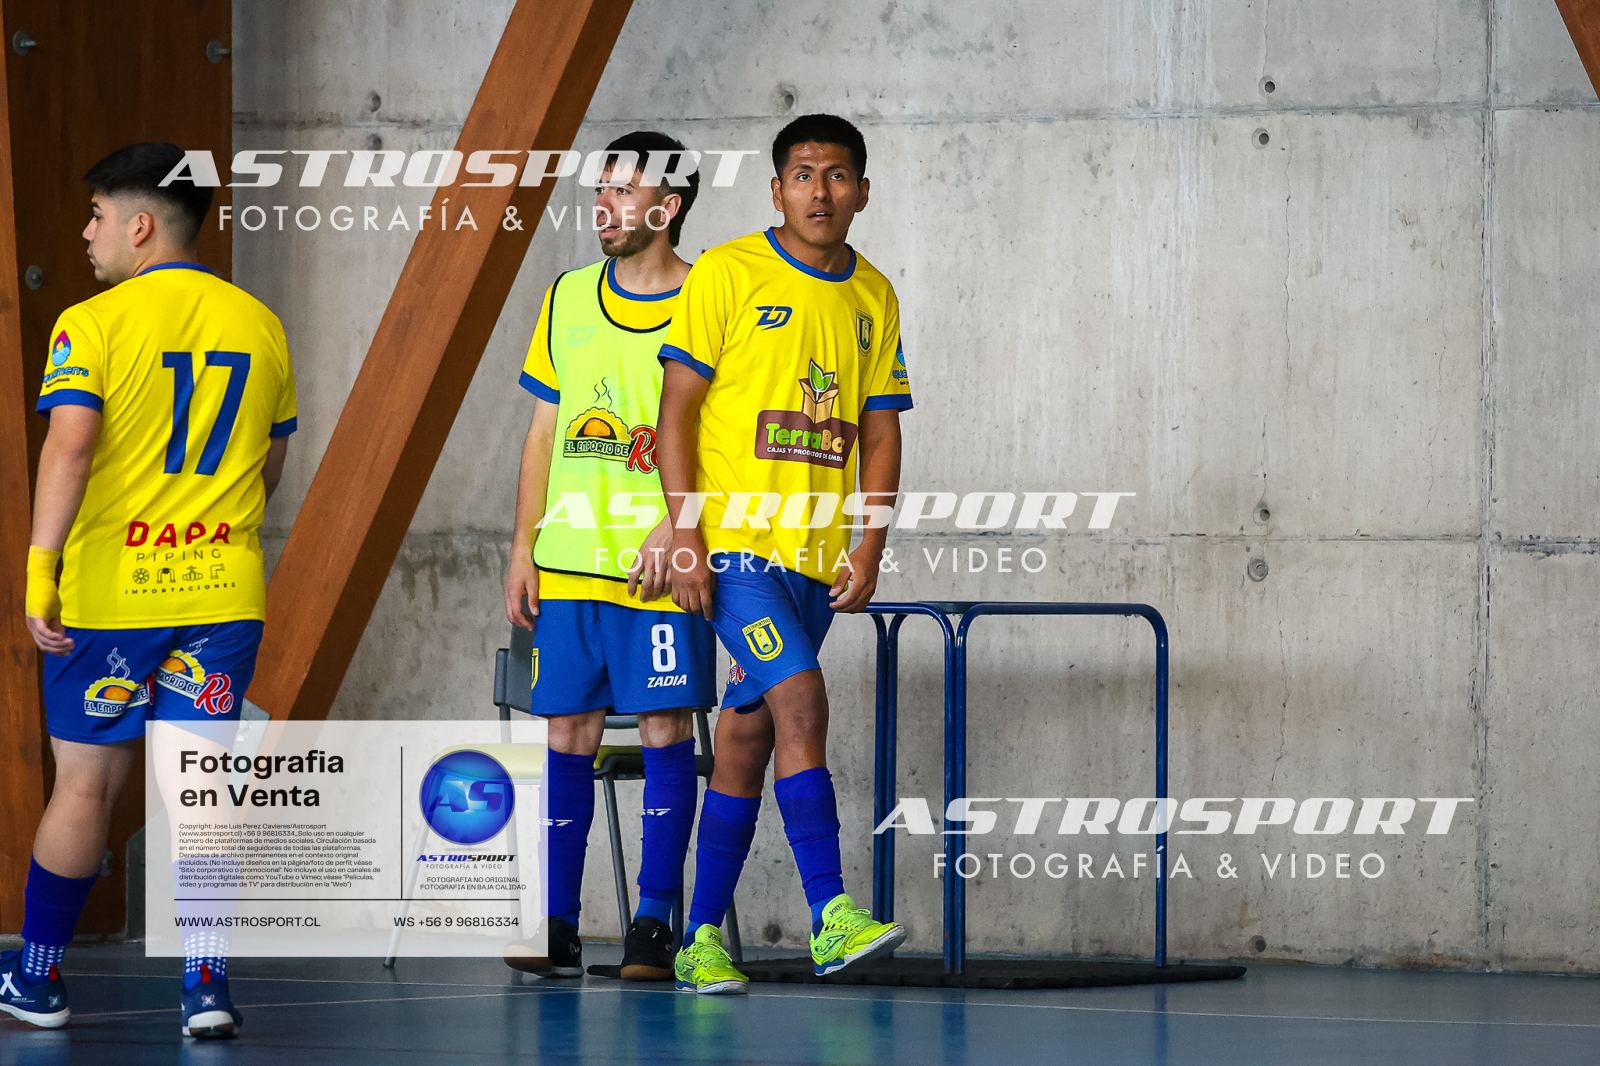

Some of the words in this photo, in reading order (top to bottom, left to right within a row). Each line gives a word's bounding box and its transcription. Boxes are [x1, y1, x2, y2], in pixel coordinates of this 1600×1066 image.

[162, 350, 251, 476] 17
[564, 441, 575, 452] EL
[615, 444, 629, 457] DE
[136, 548, 221, 562] PIPING
[125, 582, 236, 594] IMPORTACIONES
[651, 623, 676, 672] 8
[647, 674, 687, 689] ZADIA
[185, 683, 201, 697] DE
[84, 700, 96, 712] EL
